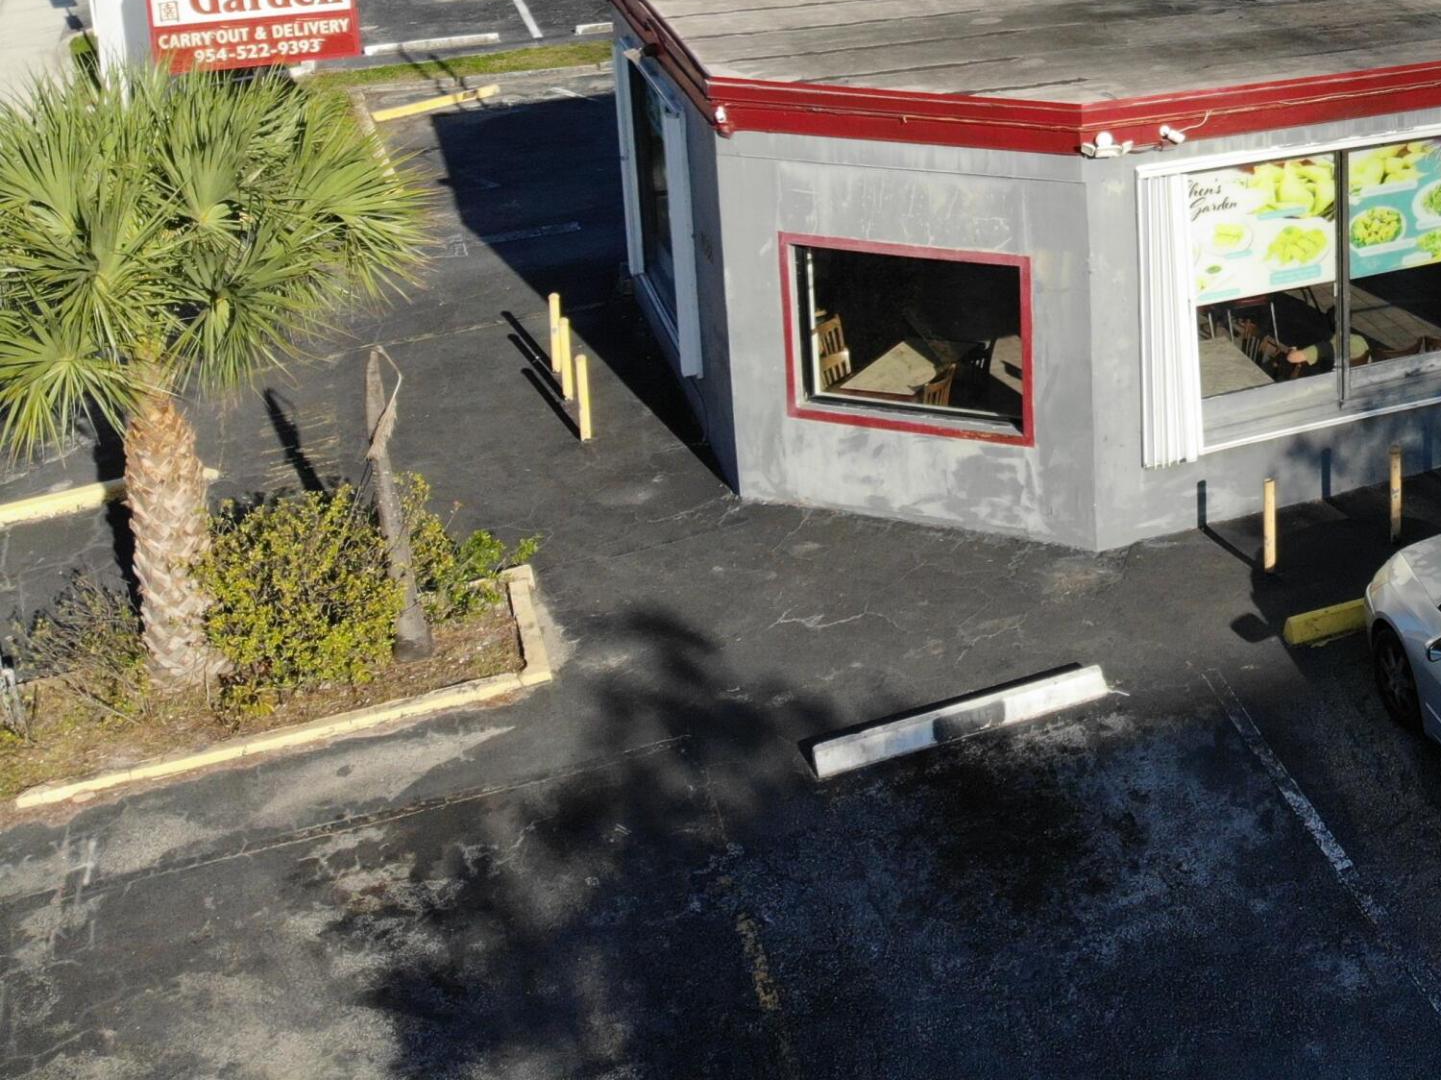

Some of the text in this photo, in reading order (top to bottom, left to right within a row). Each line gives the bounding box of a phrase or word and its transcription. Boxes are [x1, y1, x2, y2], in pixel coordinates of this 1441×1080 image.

[254, 25, 267, 40] &
[271, 18, 349, 39] DELIVERY
[194, 38, 321, 63] 954-522-9393
[1187, 178, 1222, 199] hen's
[1189, 196, 1238, 222] Garden
